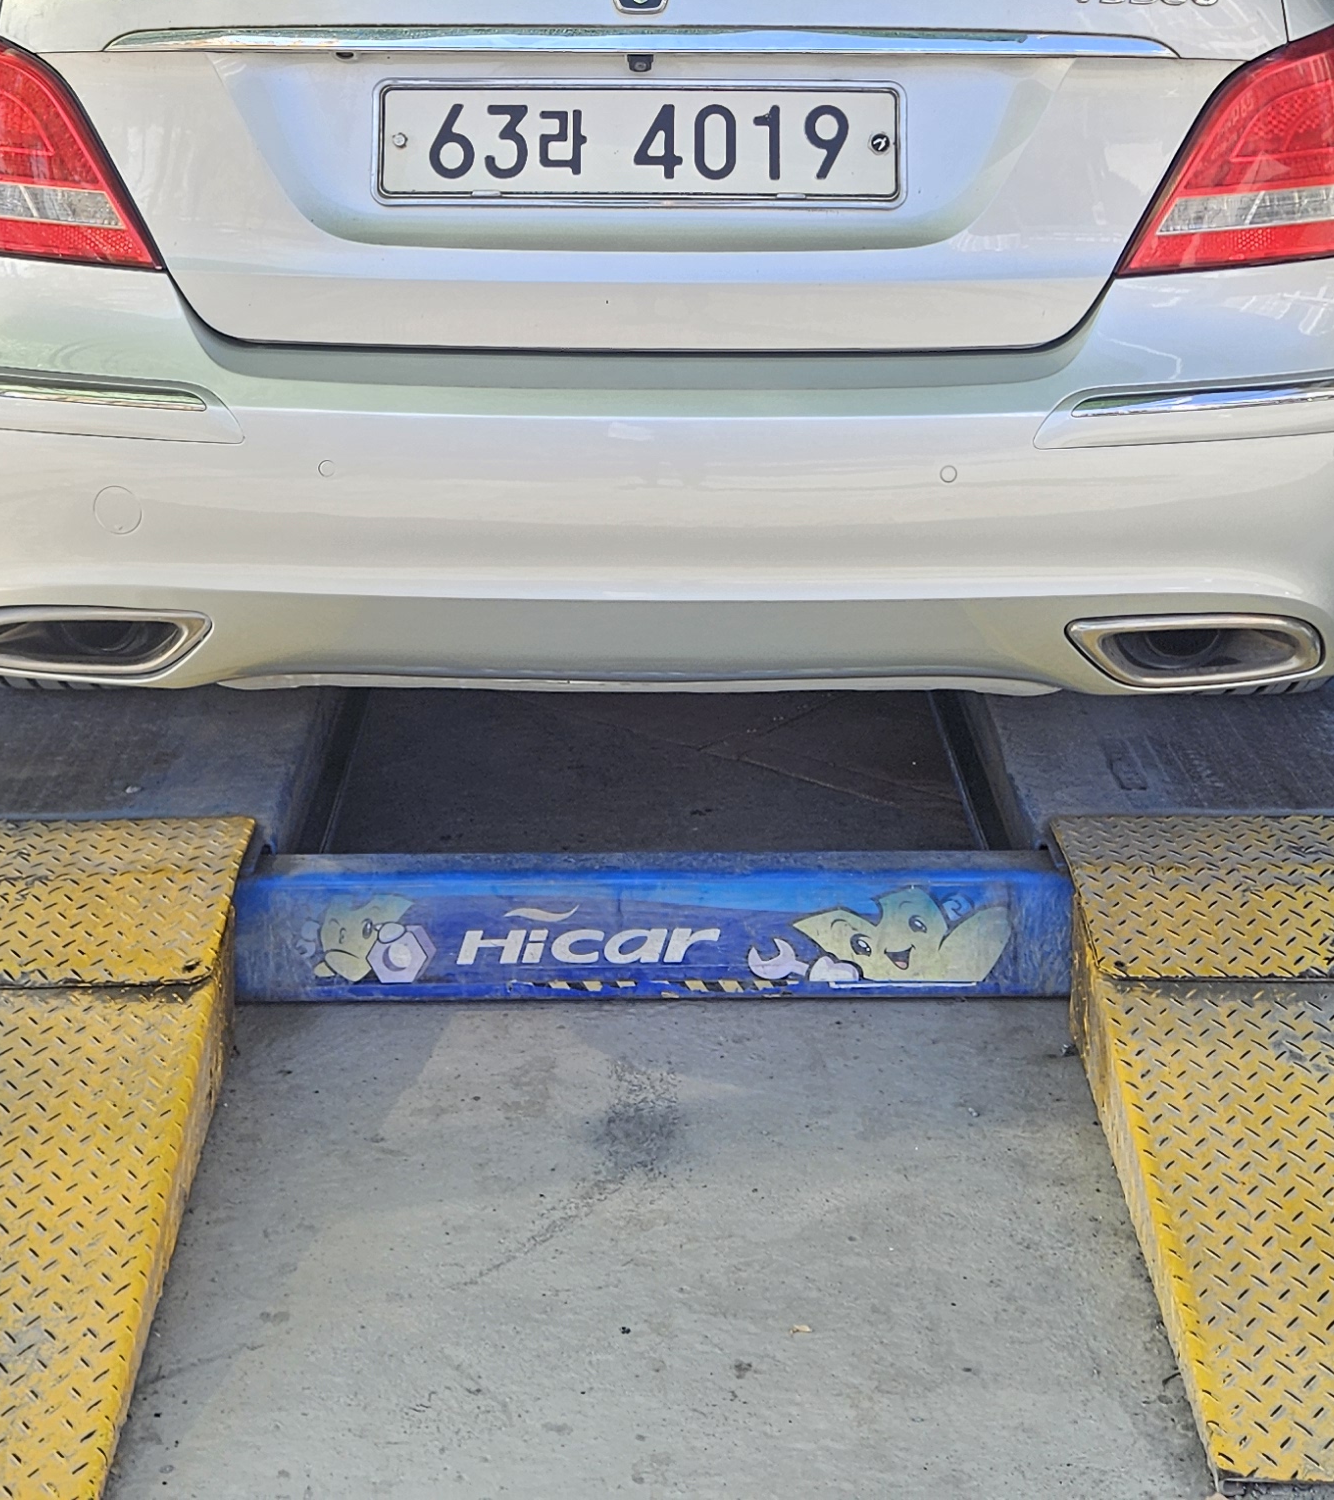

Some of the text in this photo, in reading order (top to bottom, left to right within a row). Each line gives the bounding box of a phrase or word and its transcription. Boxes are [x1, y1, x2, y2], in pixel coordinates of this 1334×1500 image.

[428, 103, 850, 180] 63라 4019
[456, 927, 722, 966] Hicar
